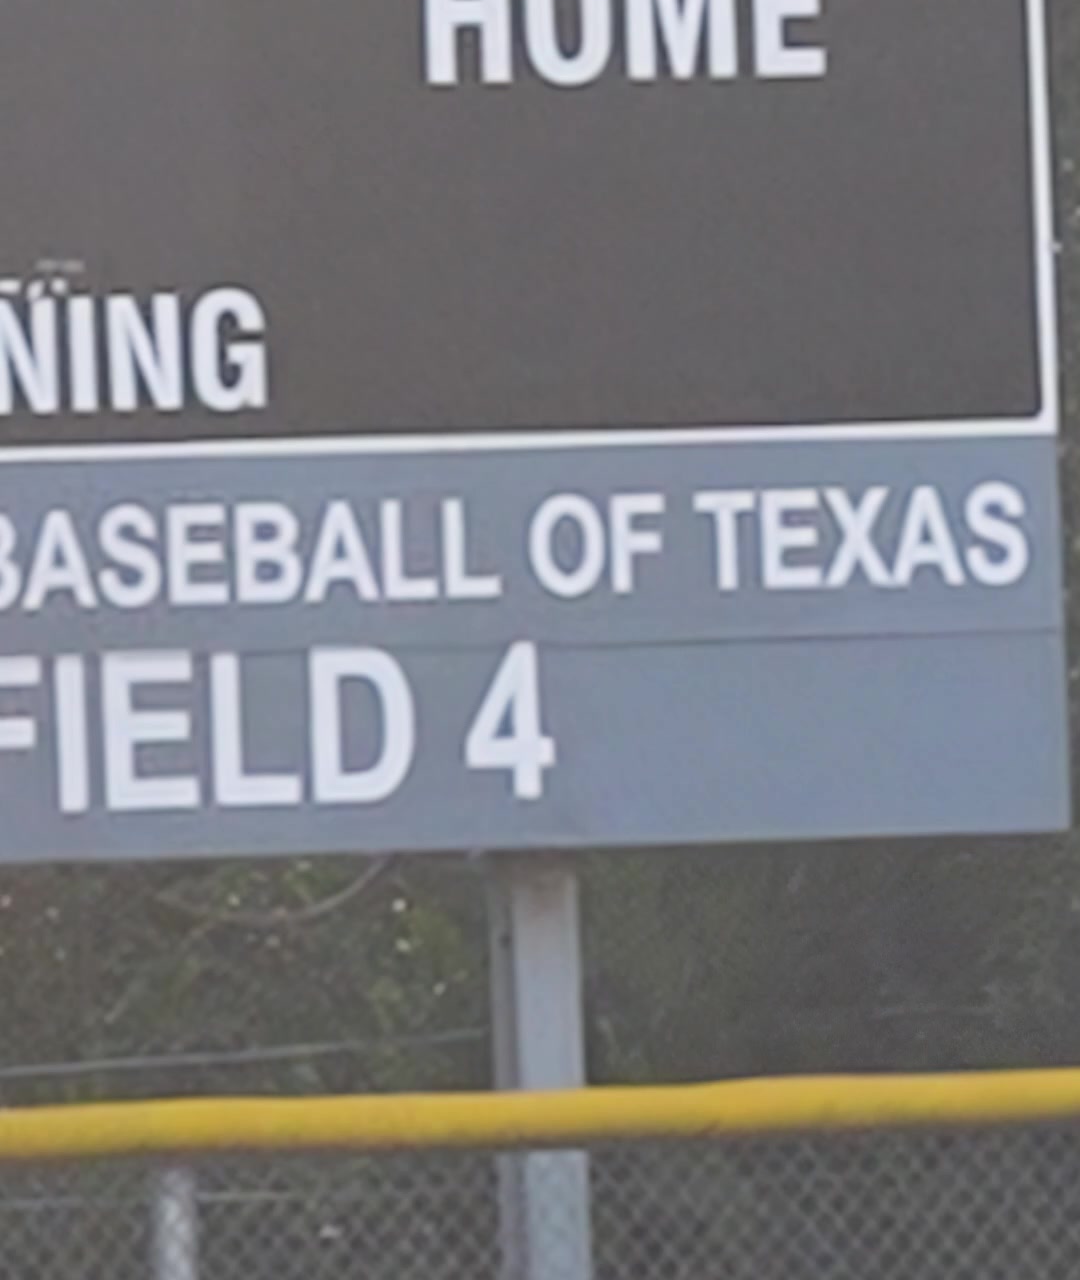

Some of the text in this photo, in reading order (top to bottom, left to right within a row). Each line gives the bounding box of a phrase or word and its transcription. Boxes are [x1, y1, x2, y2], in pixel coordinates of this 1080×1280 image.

[530, 493, 665, 597] OF
[693, 482, 1028, 590] TEXAS
[465, 641, 556, 799] 4
